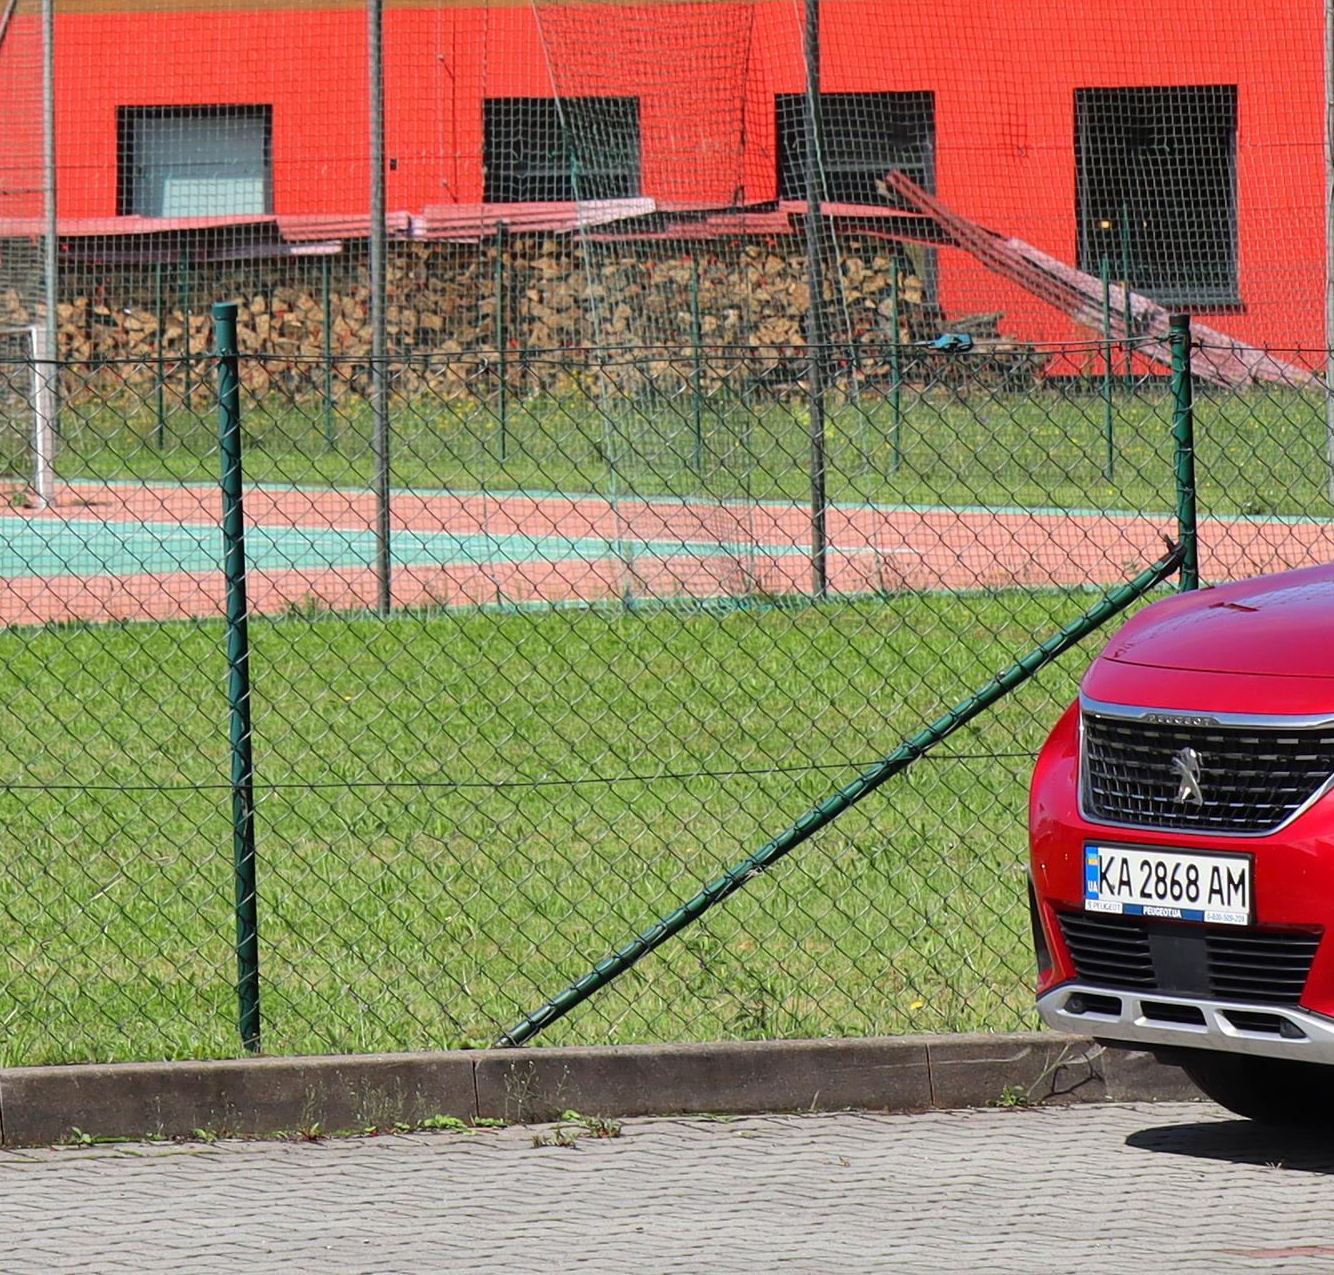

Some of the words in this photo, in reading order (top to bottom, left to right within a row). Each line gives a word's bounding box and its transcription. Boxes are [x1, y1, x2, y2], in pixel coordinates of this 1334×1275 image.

[1087, 880, 1098, 893] UA
[1099, 855, 1133, 897] KA
[1139, 859, 1200, 903] 2868
[1207, 865, 1247, 908] AM
